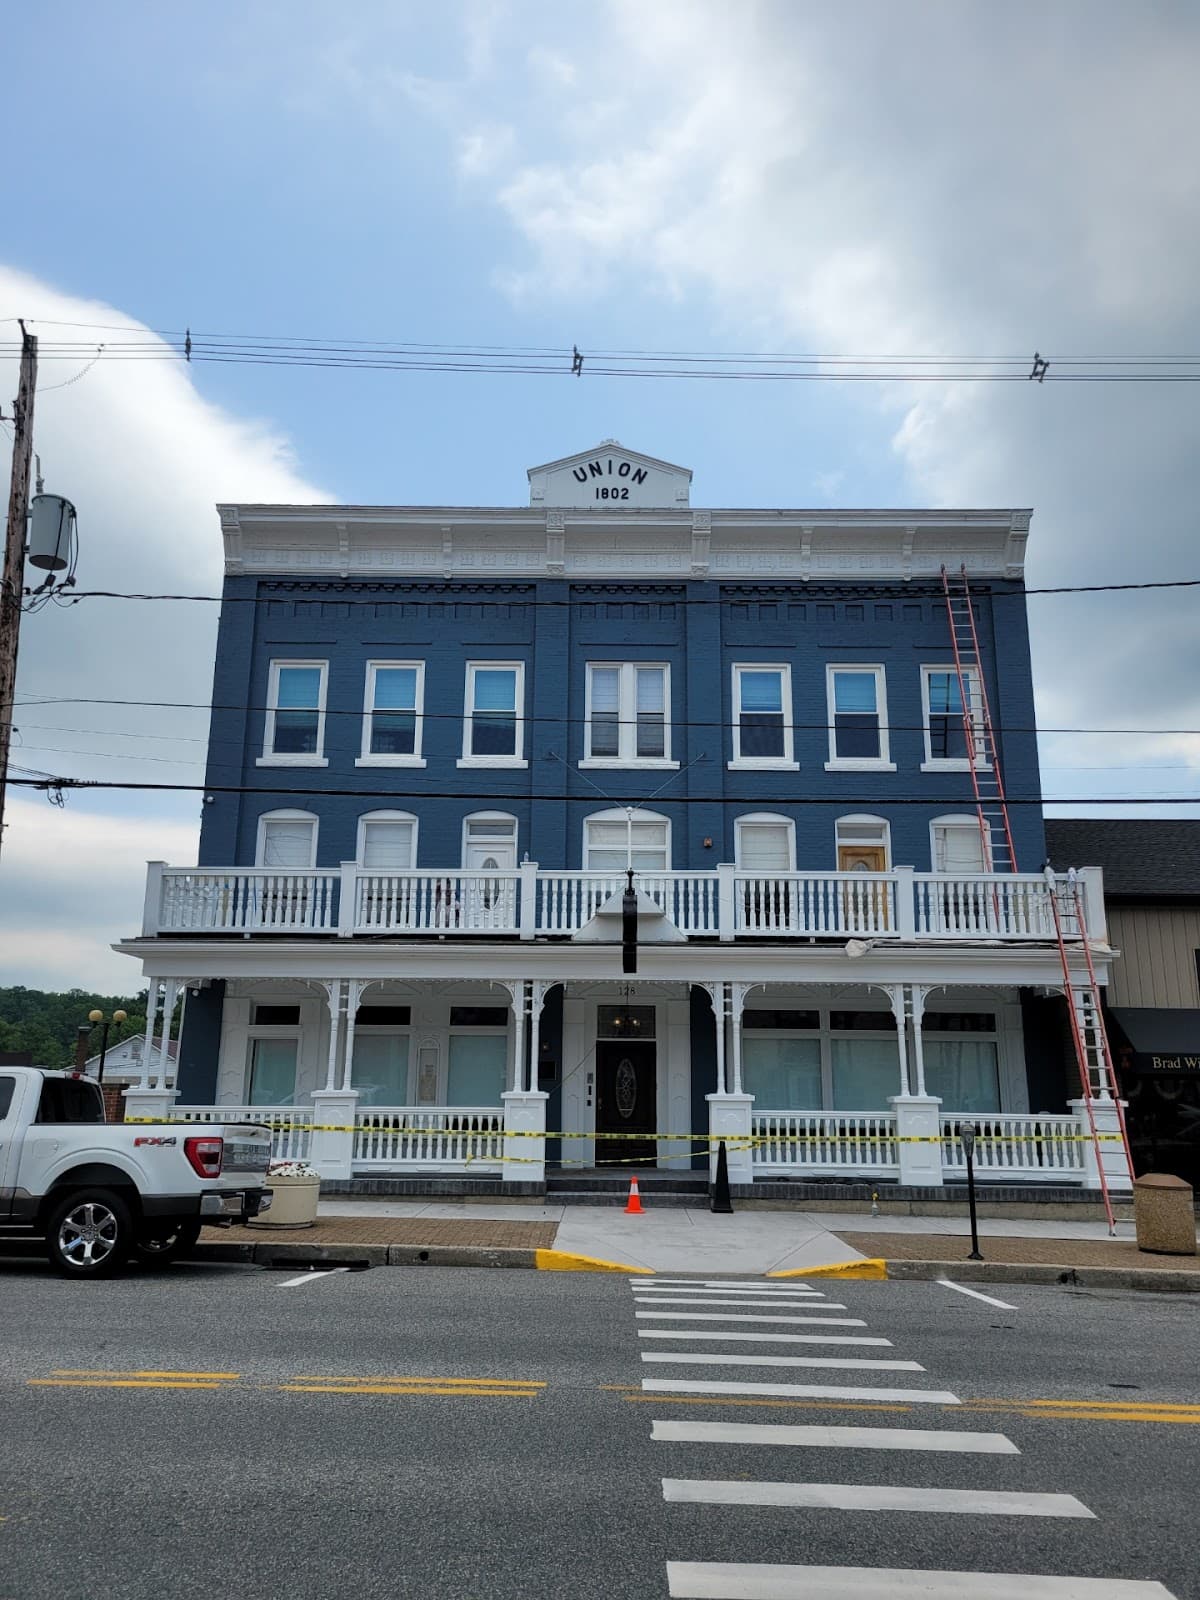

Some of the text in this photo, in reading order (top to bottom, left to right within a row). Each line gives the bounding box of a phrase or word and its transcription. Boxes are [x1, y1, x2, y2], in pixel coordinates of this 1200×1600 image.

[573, 459, 648, 485] UNION
[595, 487, 630, 500] 1802
[1152, 1056, 1181, 1069] Brad
[134, 1136, 177, 1147] FX4
